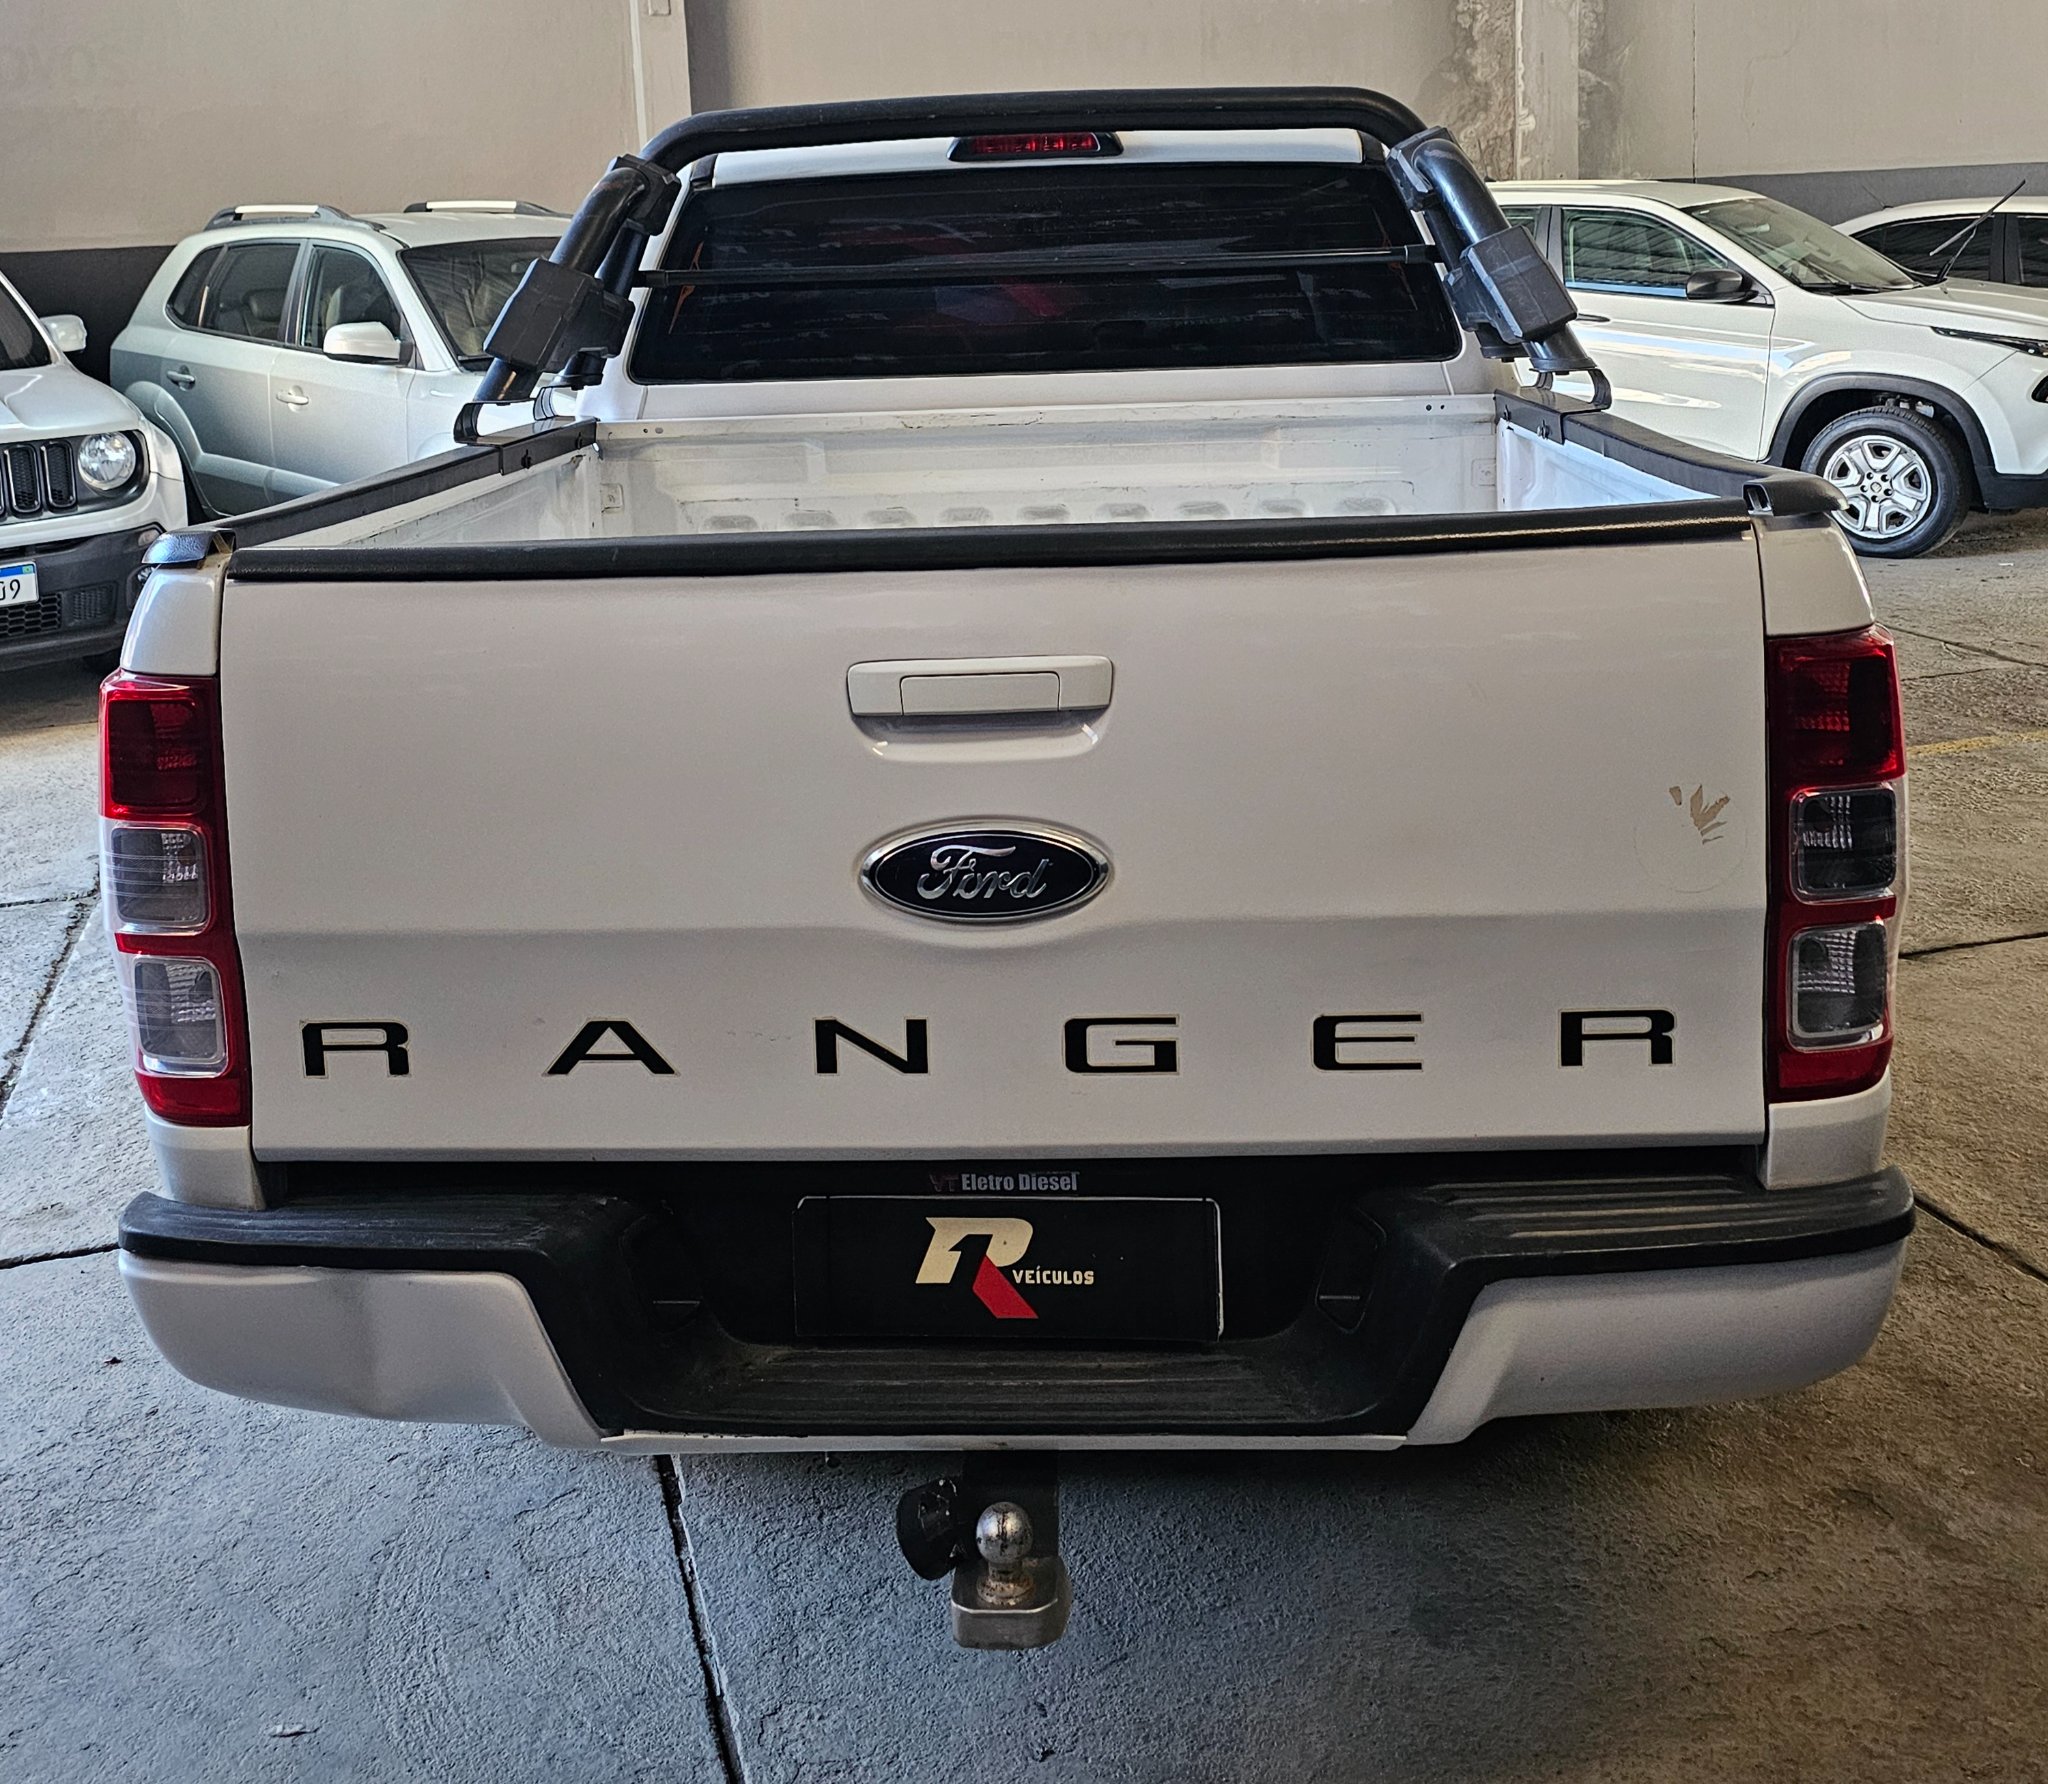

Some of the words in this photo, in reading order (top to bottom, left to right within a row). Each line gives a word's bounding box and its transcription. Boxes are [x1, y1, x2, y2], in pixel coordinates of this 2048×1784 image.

[917, 844, 1048, 900] Ford
[300, 1008, 1676, 1078] RANGER
[961, 1173, 1015, 1191] Eletro
[1018, 1173, 1079, 1191] Diesel
[1012, 1265, 1095, 1285] VEÍCULOS
